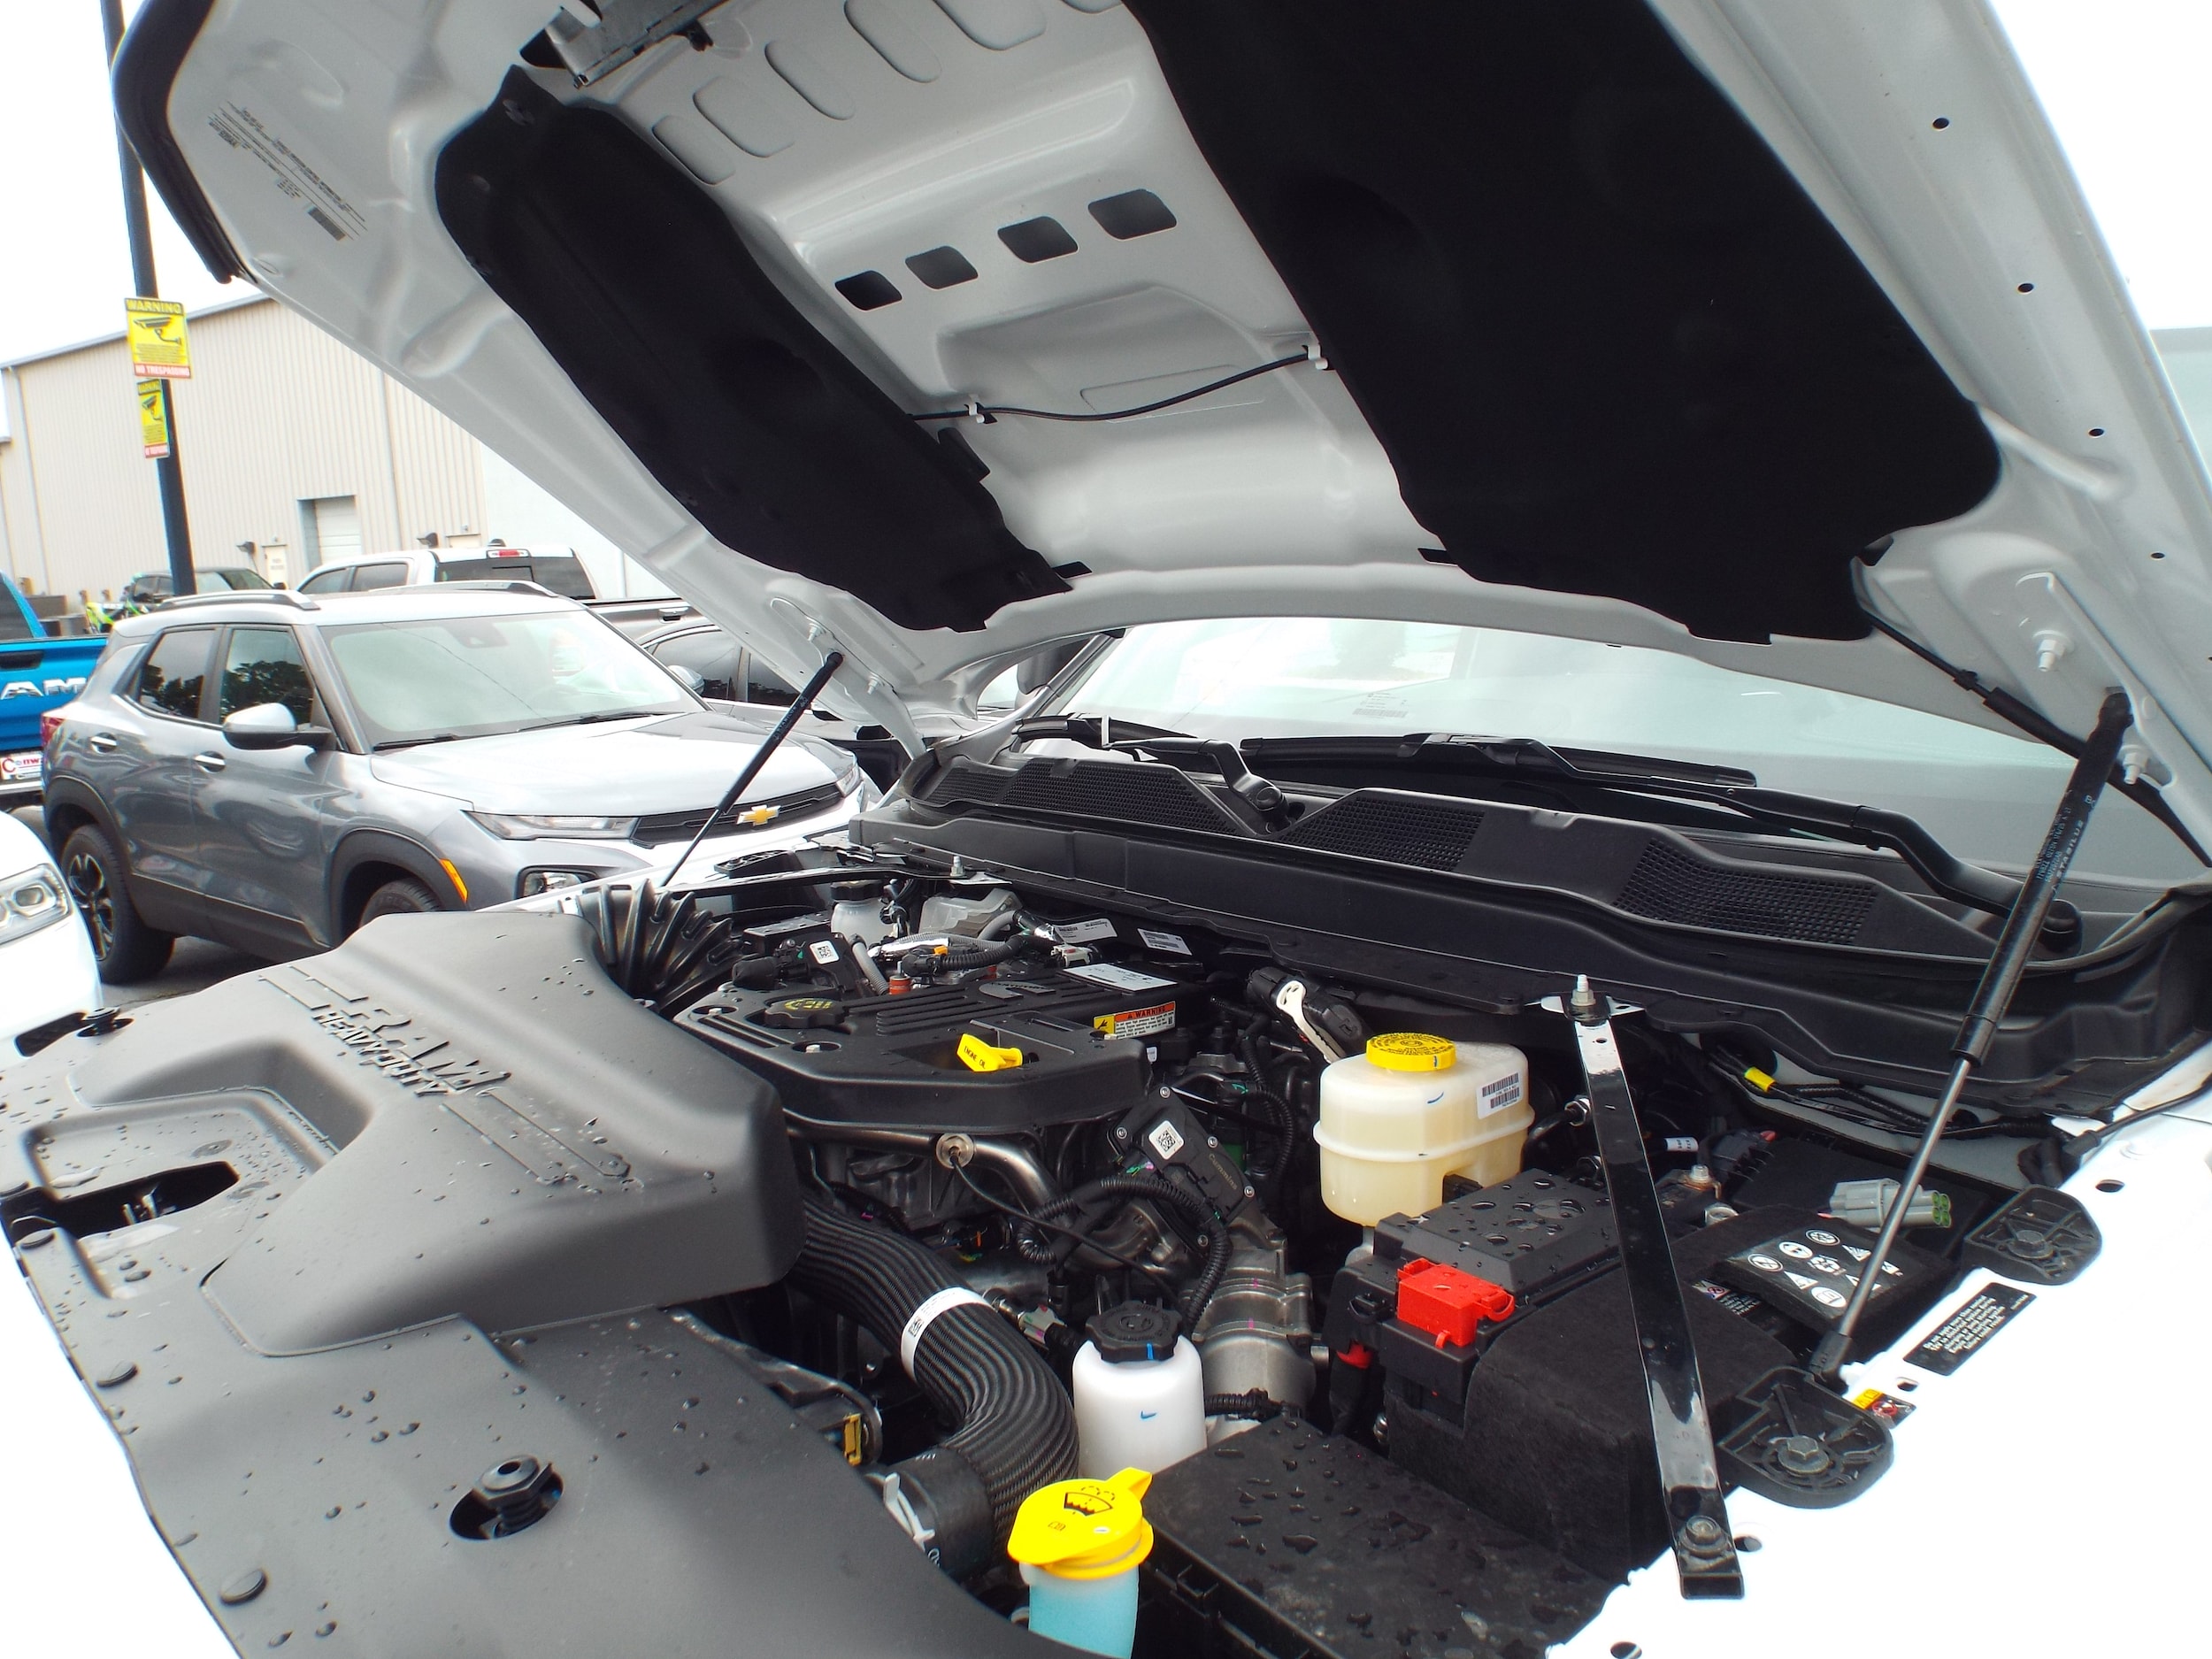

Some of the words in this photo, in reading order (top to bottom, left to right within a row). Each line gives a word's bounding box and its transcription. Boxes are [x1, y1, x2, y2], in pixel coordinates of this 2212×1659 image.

[127, 299, 181, 314] WARNING
[2056, 819, 2084, 879] STABILUS
[1136, 1006, 1166, 1018] WARNING
[312, 1011, 391, 1056] HEAVY
[964, 1045, 977, 1062] ENGINE
[1209, 1153, 1238, 1190] Cummins
